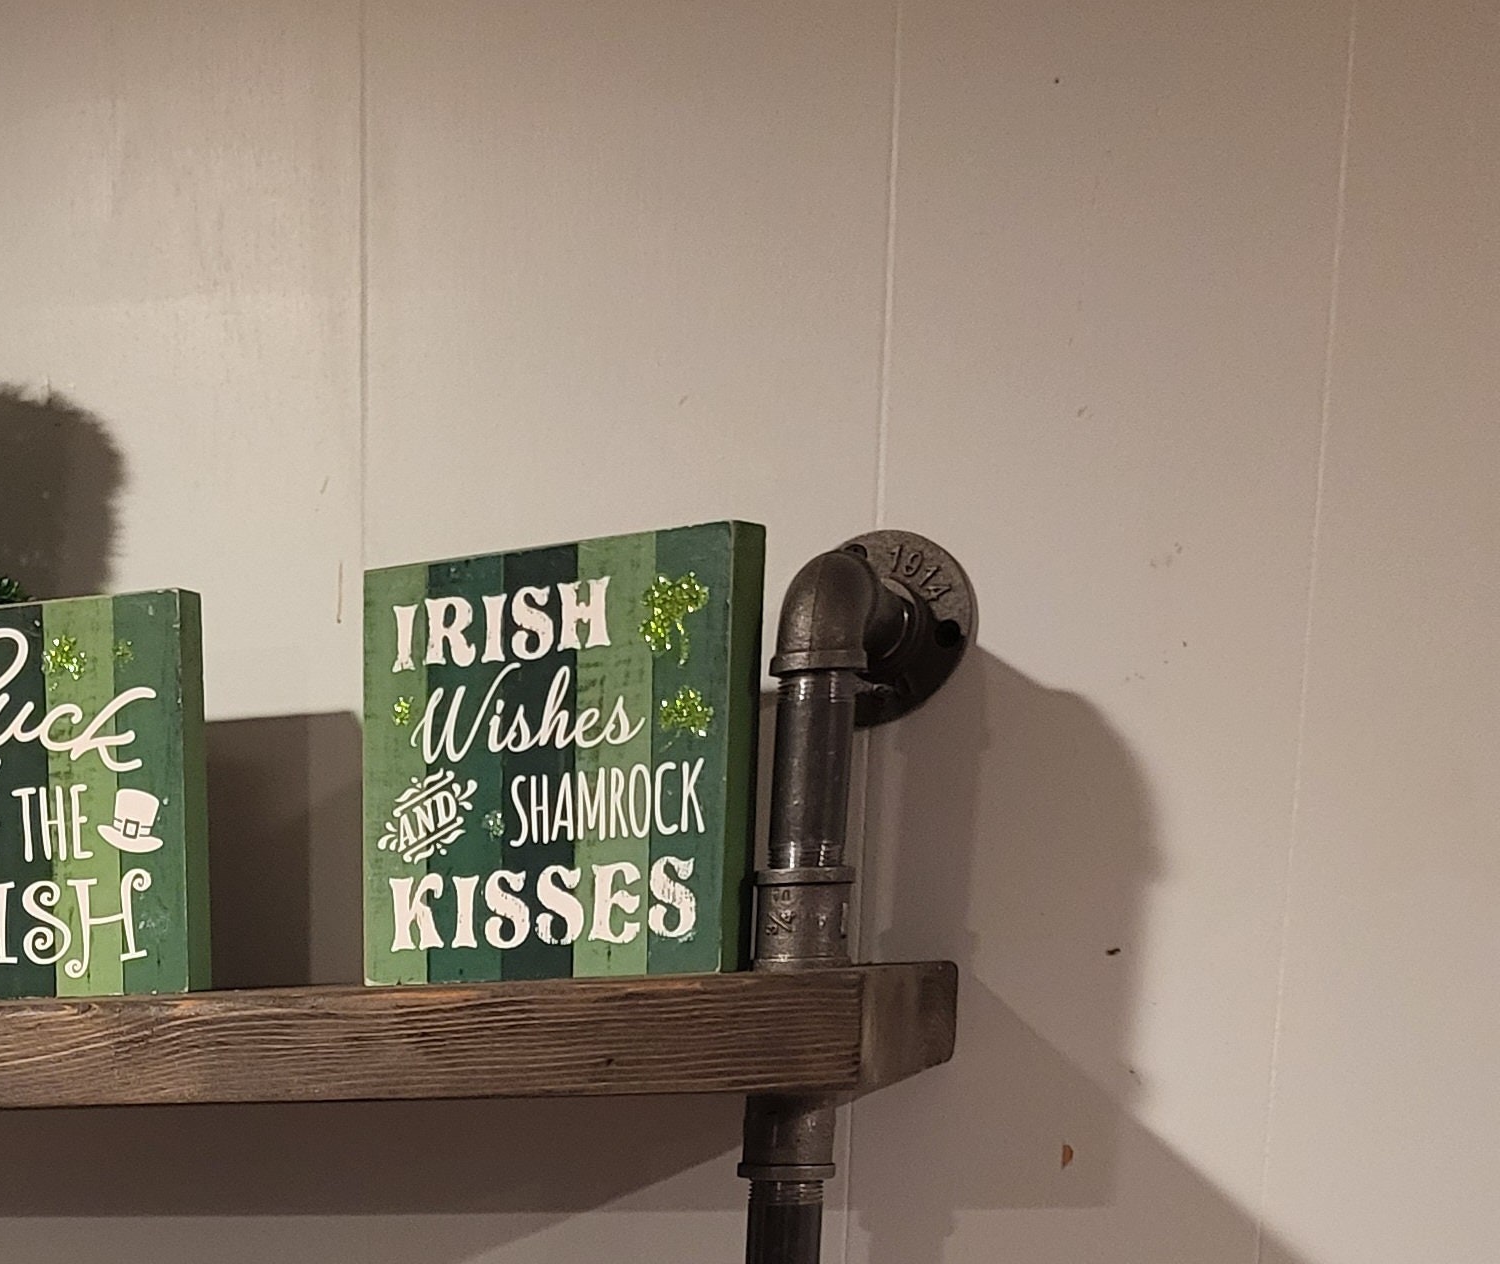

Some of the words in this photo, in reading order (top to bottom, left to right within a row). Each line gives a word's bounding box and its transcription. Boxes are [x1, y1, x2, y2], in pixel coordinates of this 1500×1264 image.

[888, 544, 952, 602] 1914
[390, 576, 612, 673] IRISH
[410, 662, 647, 765] Wishes
[11, 784, 94, 863] THE
[397, 790, 457, 853] AND
[509, 757, 706, 848] SHAMROCK
[389, 855, 697, 953] KISSES
